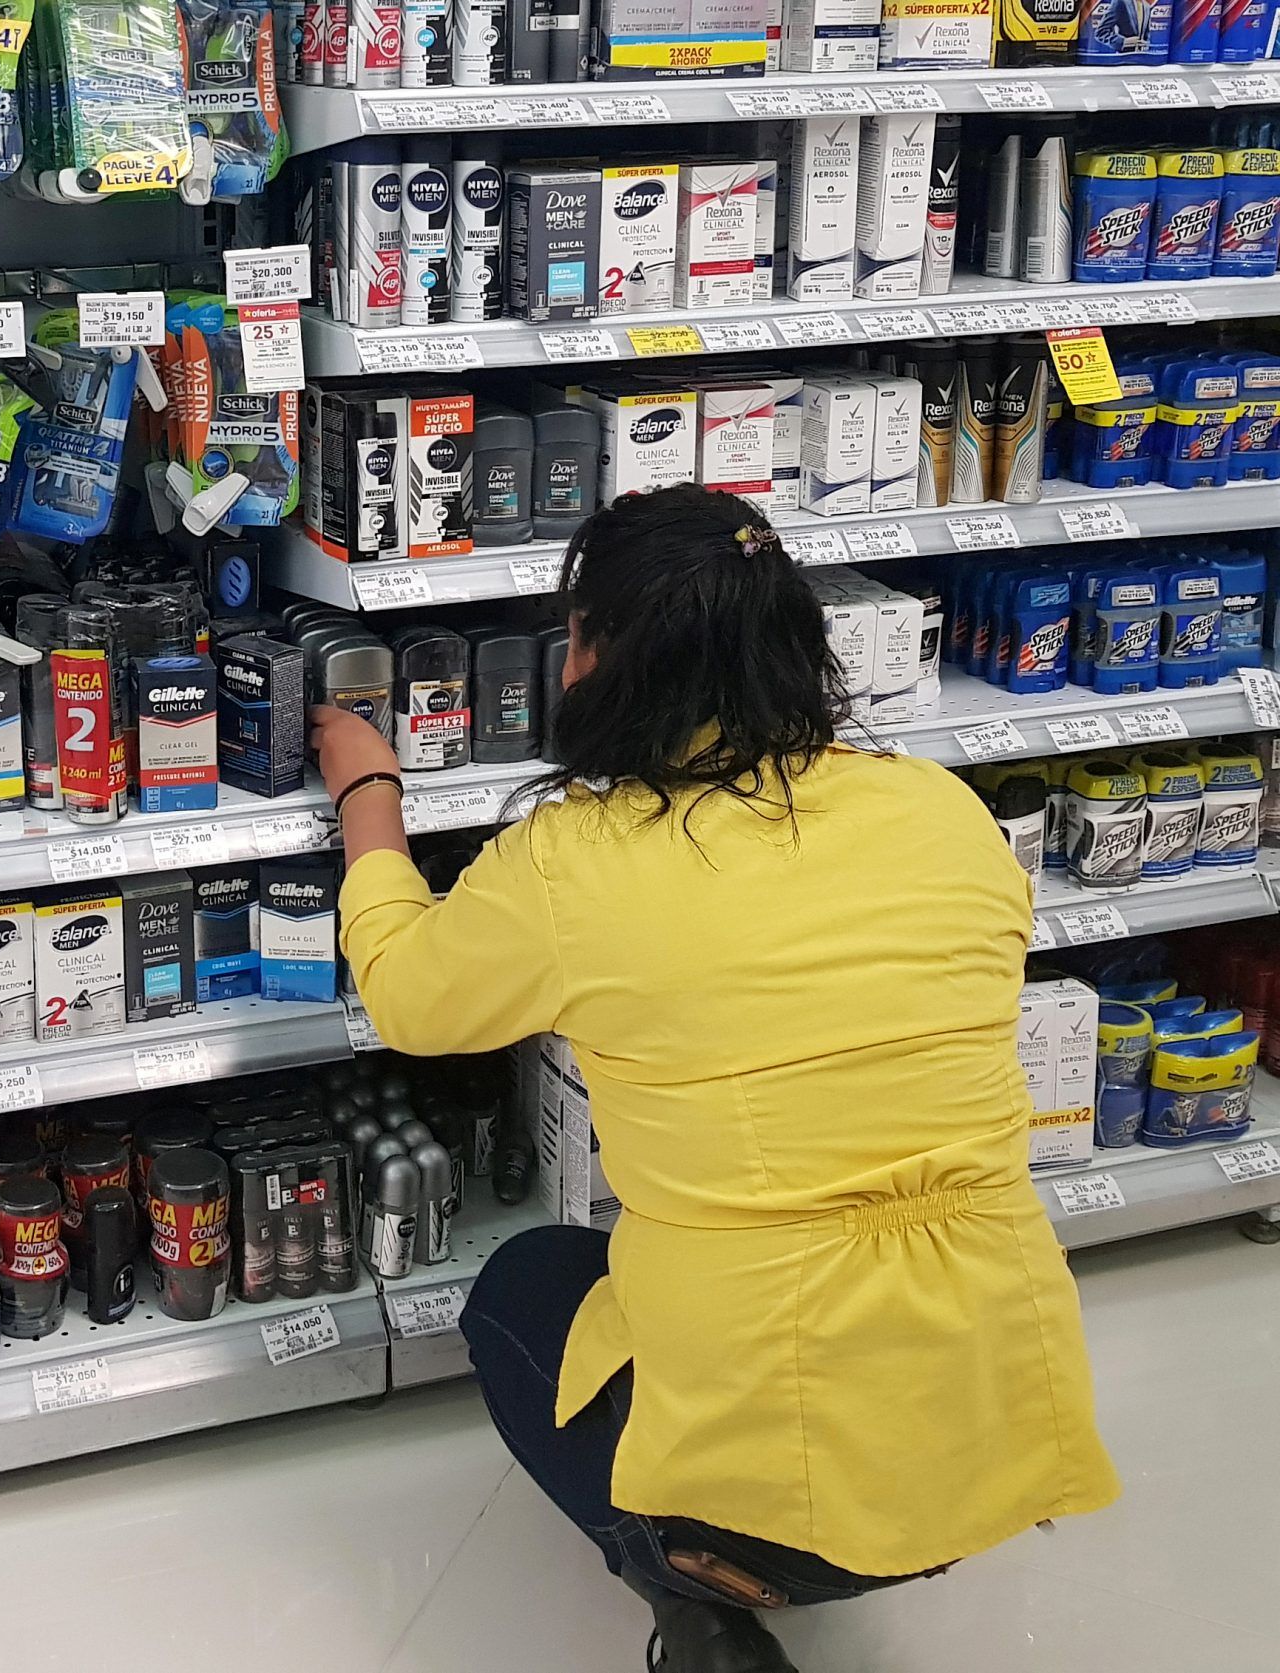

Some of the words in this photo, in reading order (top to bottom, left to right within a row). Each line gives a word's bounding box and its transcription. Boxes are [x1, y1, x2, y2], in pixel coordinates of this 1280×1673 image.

[904, 4, 932, 14] SÚPER
[934, 3, 969, 14] OFERTA
[971, 1, 989, 14] X2
[935, 26, 969, 38] Rexona
[669, 47, 712, 59] 2XPACK
[671, 57, 709, 66] AHORRO
[200, 64, 241, 76] Schick
[263, 30, 274, 111] PRUÉBALA
[189, 93, 240, 105] HYDRO
[242, 91, 258, 108] 5
[1107, 156, 1116, 174] 2
[1116, 155, 1146, 165] PRECIO
[1115, 165, 1146, 175] ESPECIAL
[617, 168, 641, 177] SÚPER
[642, 167, 664, 176] OFERTA
[891, 170, 922, 179] AEROSOL
[411, 182, 445, 192] NIVEA
[414, 191, 442, 201] MEN
[547, 191, 587, 209] Dove
[614, 193, 666, 207] Balance
[546, 210, 574, 222] MEN
[705, 206, 744, 218] Rexona
[546, 217, 586, 230] +CARE
[703, 220, 740, 229] CLINICAL
[1100, 208, 1141, 231] SPEED
[618, 224, 661, 235] CLINICAL
[1104, 221, 1142, 244] STICK
[411, 232, 444, 243] INVISIBLE
[548, 240, 585, 249] CLINICAL
[251, 309, 276, 317] oferta
[253, 326, 274, 339] 25
[1057, 328, 1081, 336] oferta
[1059, 356, 1084, 371] 50
[193, 357, 209, 423] NUEVA
[416, 404, 440, 412] NUEVO
[441, 401, 470, 410] TAMAÑO
[426, 412, 460, 424] SÚPER
[424, 422, 463, 434] PRECIO
[50, 441, 89, 454] TITANIUM
[430, 449, 453, 457] NIVEA
[425, 475, 459, 486] INVISIBLE
[426, 543, 461, 553] AEROSOL
[1223, 595, 1257, 607] Gillette
[57, 672, 102, 690] MEGA
[57, 687, 103, 700] CONTENIDO
[417, 717, 442, 728] SÚPER
[446, 715, 463, 726] X2
[66, 708, 96, 751] 2
[153, 772, 179, 781] PRESSURE
[182, 771, 206, 779] DEFENSE
[1103, 823, 1139, 845] SPEED
[1106, 839, 1139, 858] STICK
[60, 939, 79, 949] MEN
[75, 975, 115, 986] PROTECTION
[1073, 1108, 1090, 1122] X2
[15, 1219, 59, 1242] MEGA
